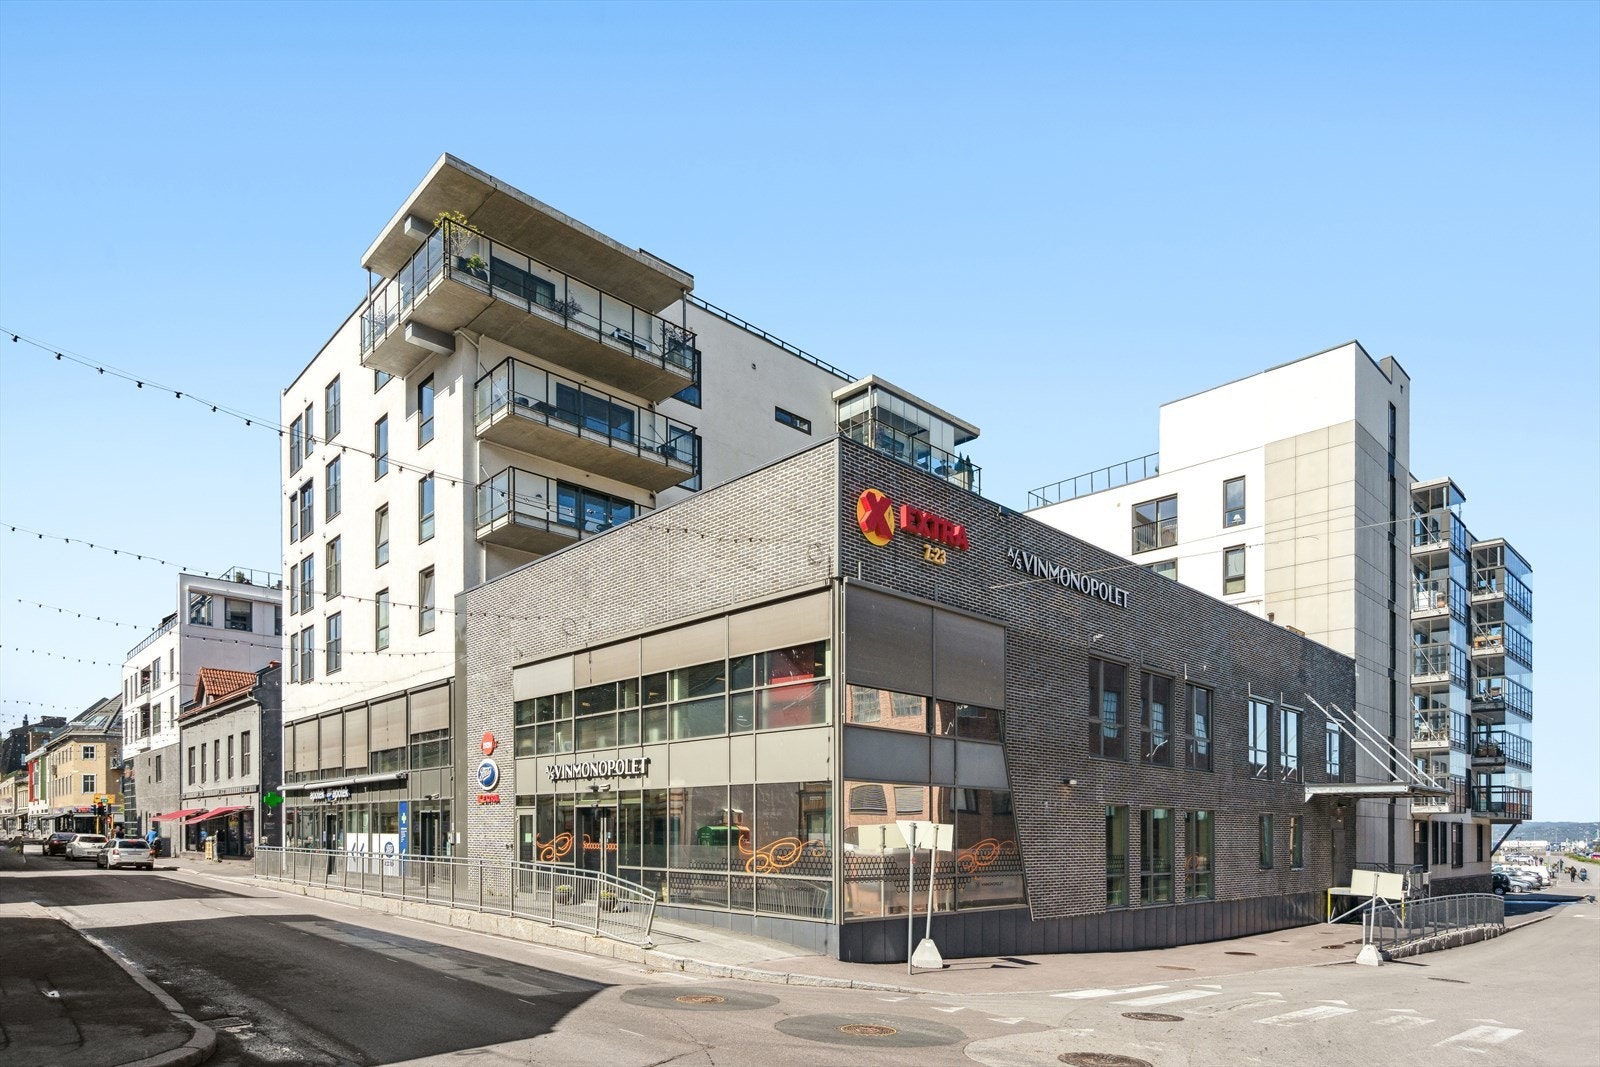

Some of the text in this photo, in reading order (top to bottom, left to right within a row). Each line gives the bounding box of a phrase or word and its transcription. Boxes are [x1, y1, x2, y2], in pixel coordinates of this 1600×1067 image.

[900, 503, 970, 552] EXTRA
[1022, 551, 1130, 609] VINMONOPOLET
[555, 757, 648, 780] VINMONOPOLET
